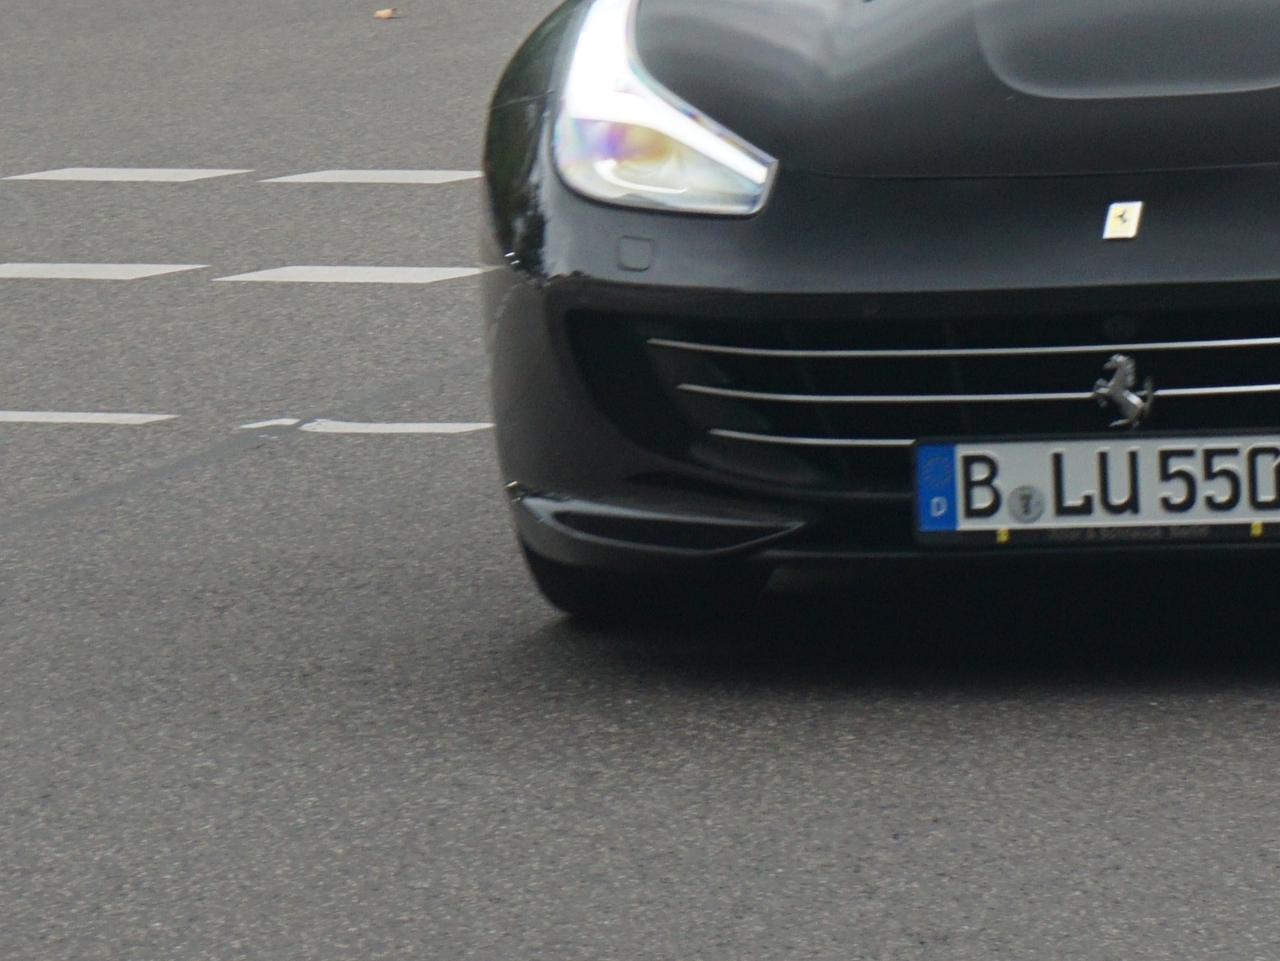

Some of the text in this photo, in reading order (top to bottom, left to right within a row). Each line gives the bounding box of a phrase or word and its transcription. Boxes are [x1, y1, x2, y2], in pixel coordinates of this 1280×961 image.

[931, 496, 948, 517] D
[961, 453, 1000, 518] B
[1052, 448, 1140, 517] LU
